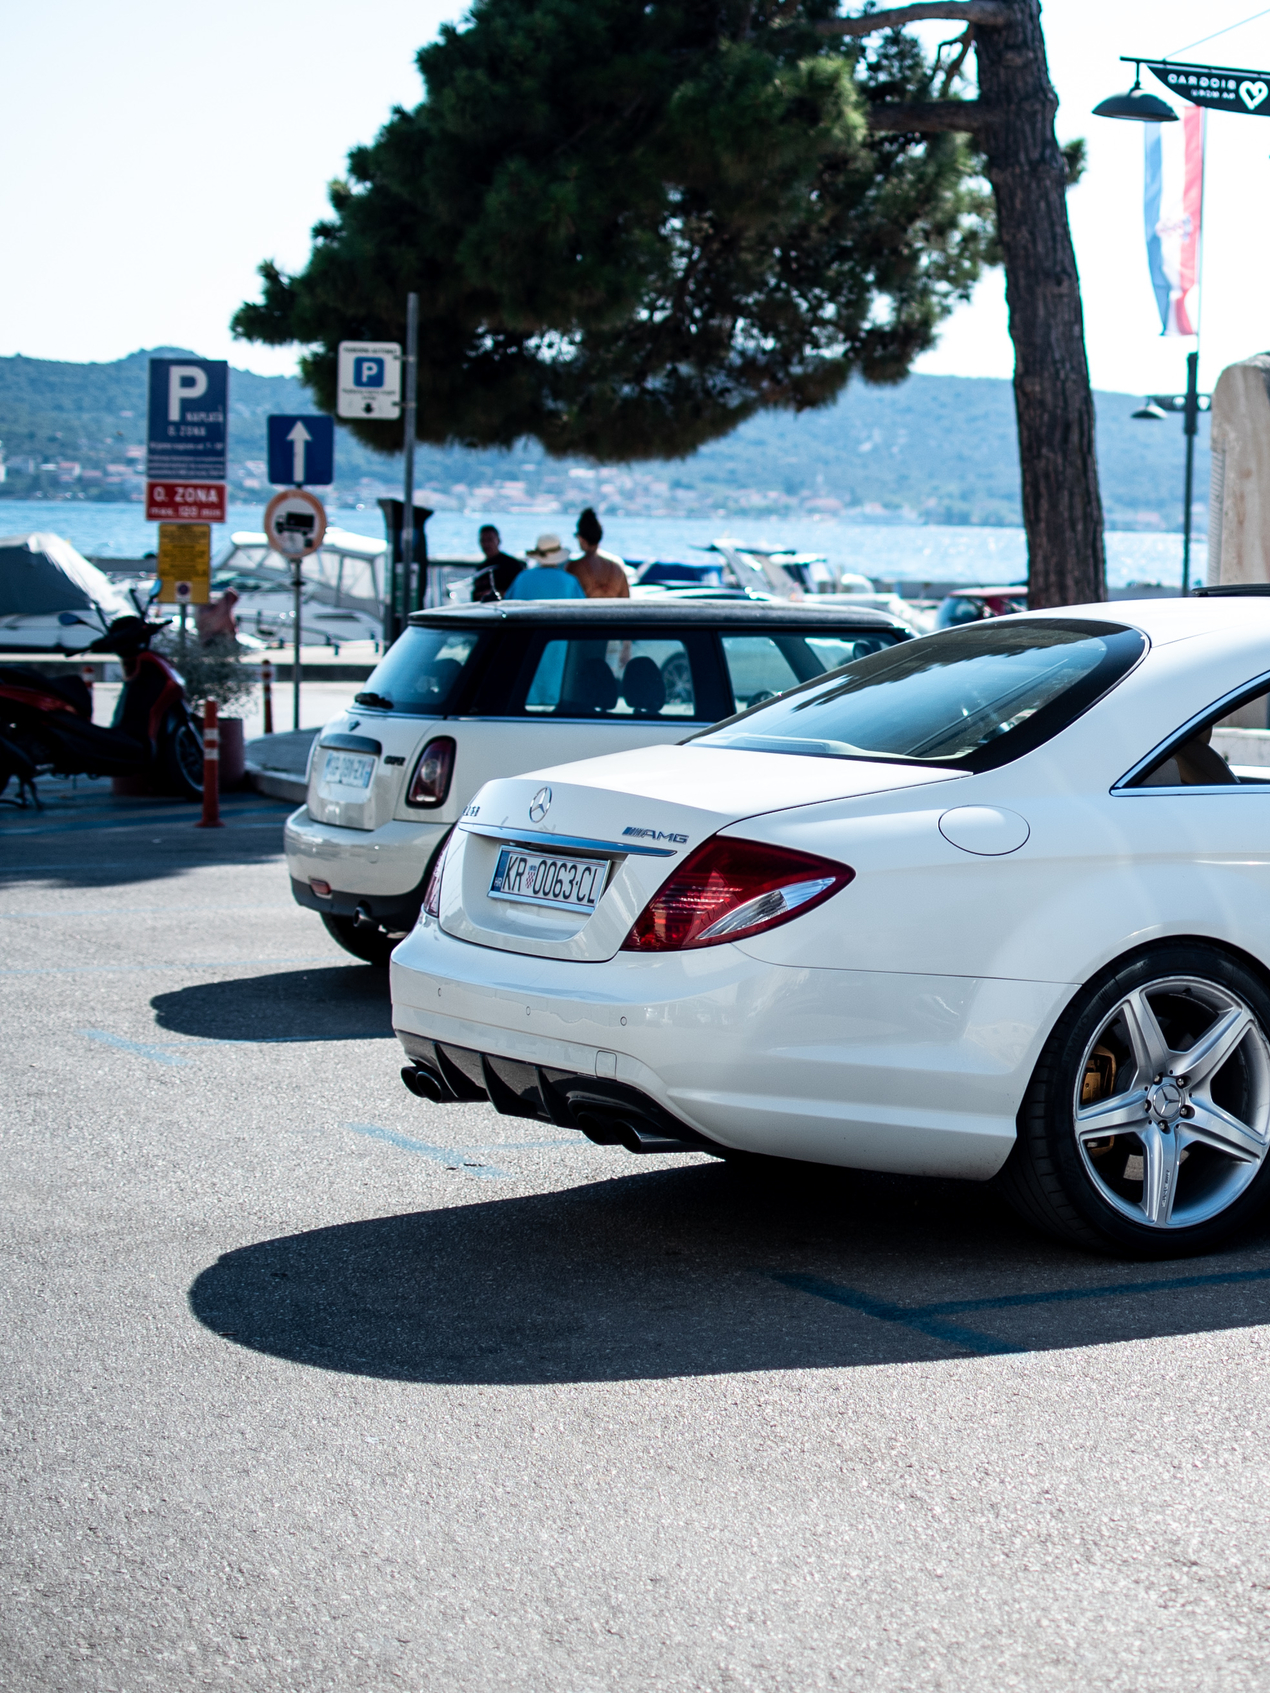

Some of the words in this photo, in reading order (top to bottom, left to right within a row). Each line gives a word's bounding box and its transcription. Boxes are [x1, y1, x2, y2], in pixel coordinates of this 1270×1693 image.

[362, 362, 378, 382] P
[168, 365, 208, 422] P
[180, 425, 206, 437] ZONA
[174, 487, 219, 504] ZONA
[641, 828, 690, 844] AMG
[502, 856, 528, 892] KR
